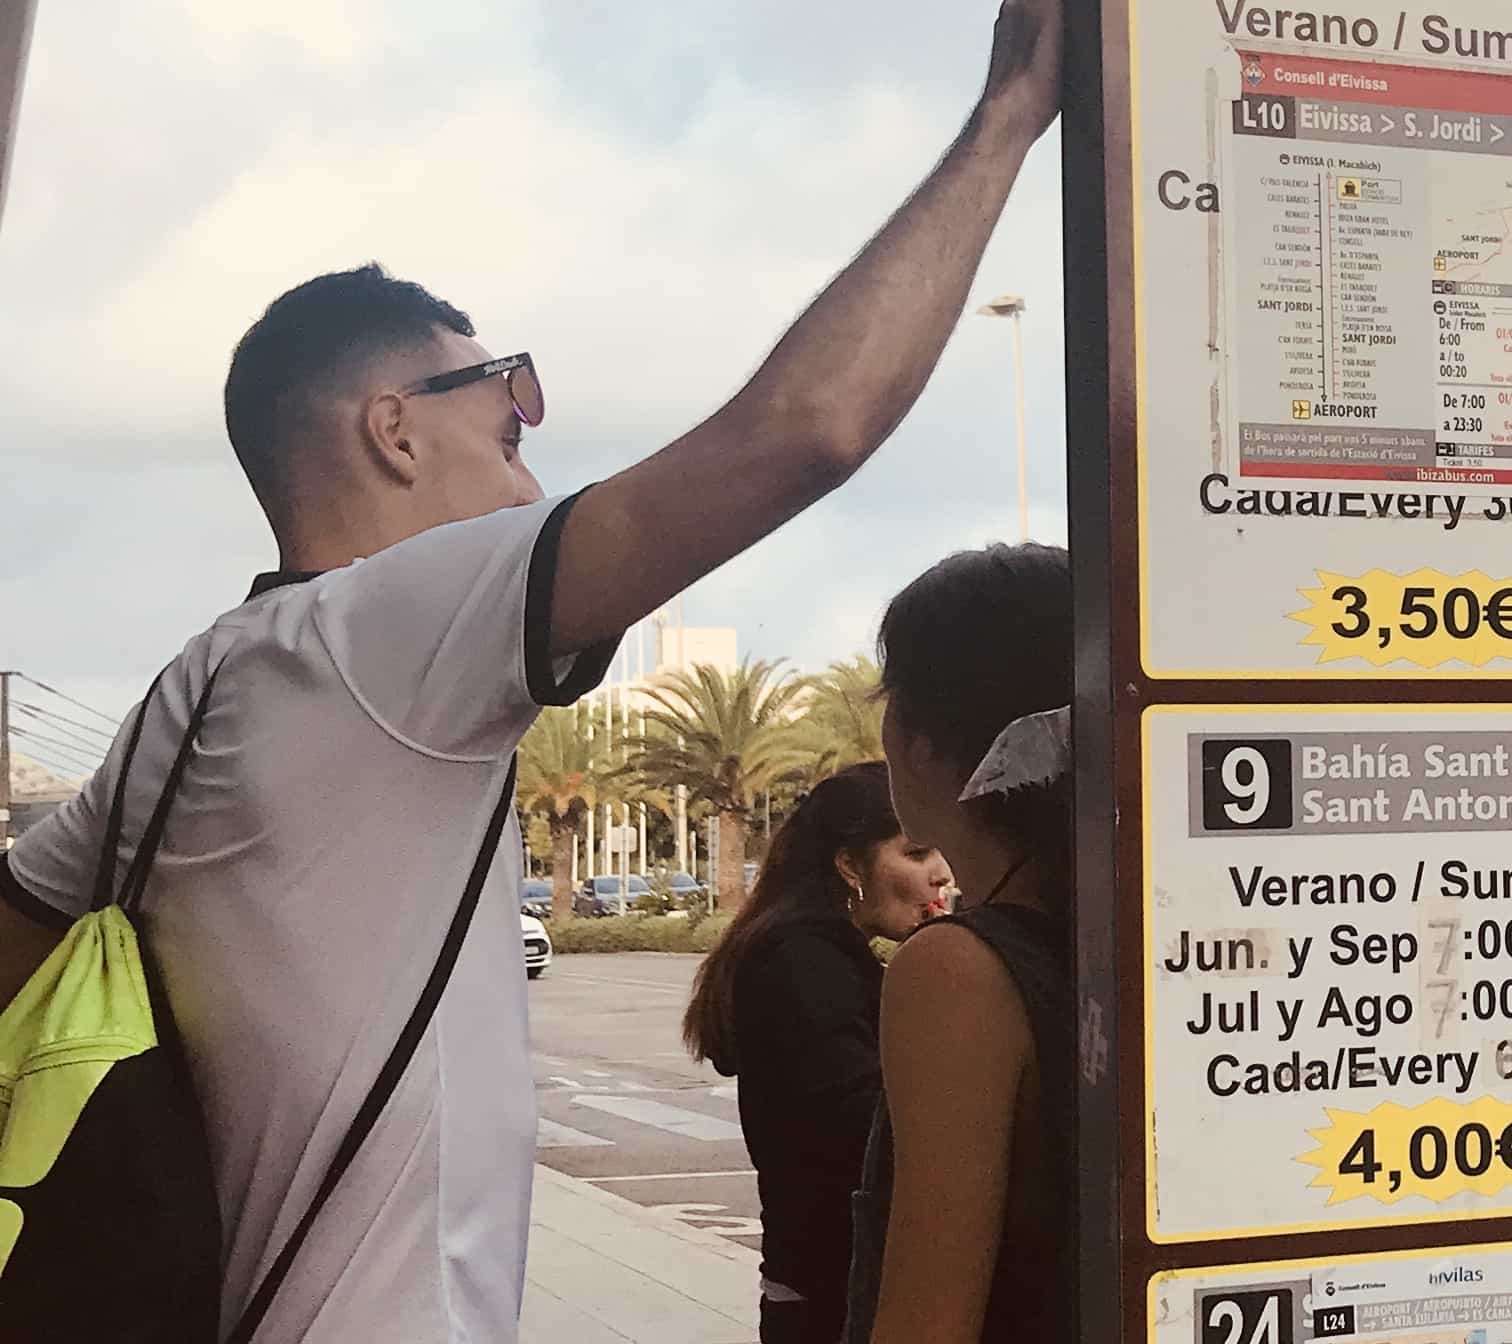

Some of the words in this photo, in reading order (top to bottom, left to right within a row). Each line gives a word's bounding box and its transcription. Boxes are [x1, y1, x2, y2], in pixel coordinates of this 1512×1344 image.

[1273, 67, 1325, 87] Consell
[1328, 71, 1388, 92] d'Eivissa
[1242, 100, 1286, 131] L10
[1300, 103, 1372, 134] Eivissa
[1404, 114, 1423, 138] S.
[1430, 115, 1482, 143] Jordi
[1257, 300, 1282, 311] SANT
[1439, 317, 1451, 330] De
[1460, 318, 1485, 332] From
[1342, 333, 1366, 344] SANT
[1369, 334, 1396, 346] JORDI
[1439, 334, 1461, 346] 6:00
[1440, 365, 1467, 378] 00:20
[1314, 405, 1378, 419] AEROPORT
[1443, 394, 1458, 408] De
[1460, 395, 1485, 409] 7:00
[1453, 417, 1482, 432] 23:30
[1302, 742, 1411, 780] Bahía
[1424, 743, 1509, 778] Sant
[1221, 746, 1271, 824] 9
[1302, 789, 1390, 824] Sant
[1229, 866, 1397, 907] Verano
[1164, 931, 1270, 973] Jun.
[1288, 935, 1313, 979] y
[1330, 925, 1418, 976] Sep
[1187, 991, 1259, 1035] Jul
[1277, 998, 1303, 1042] y
[1317, 987, 1413, 1037] Ago
[1206, 1047, 1479, 1096] Cada/Every
[1323, 1312, 1346, 1332] L24
